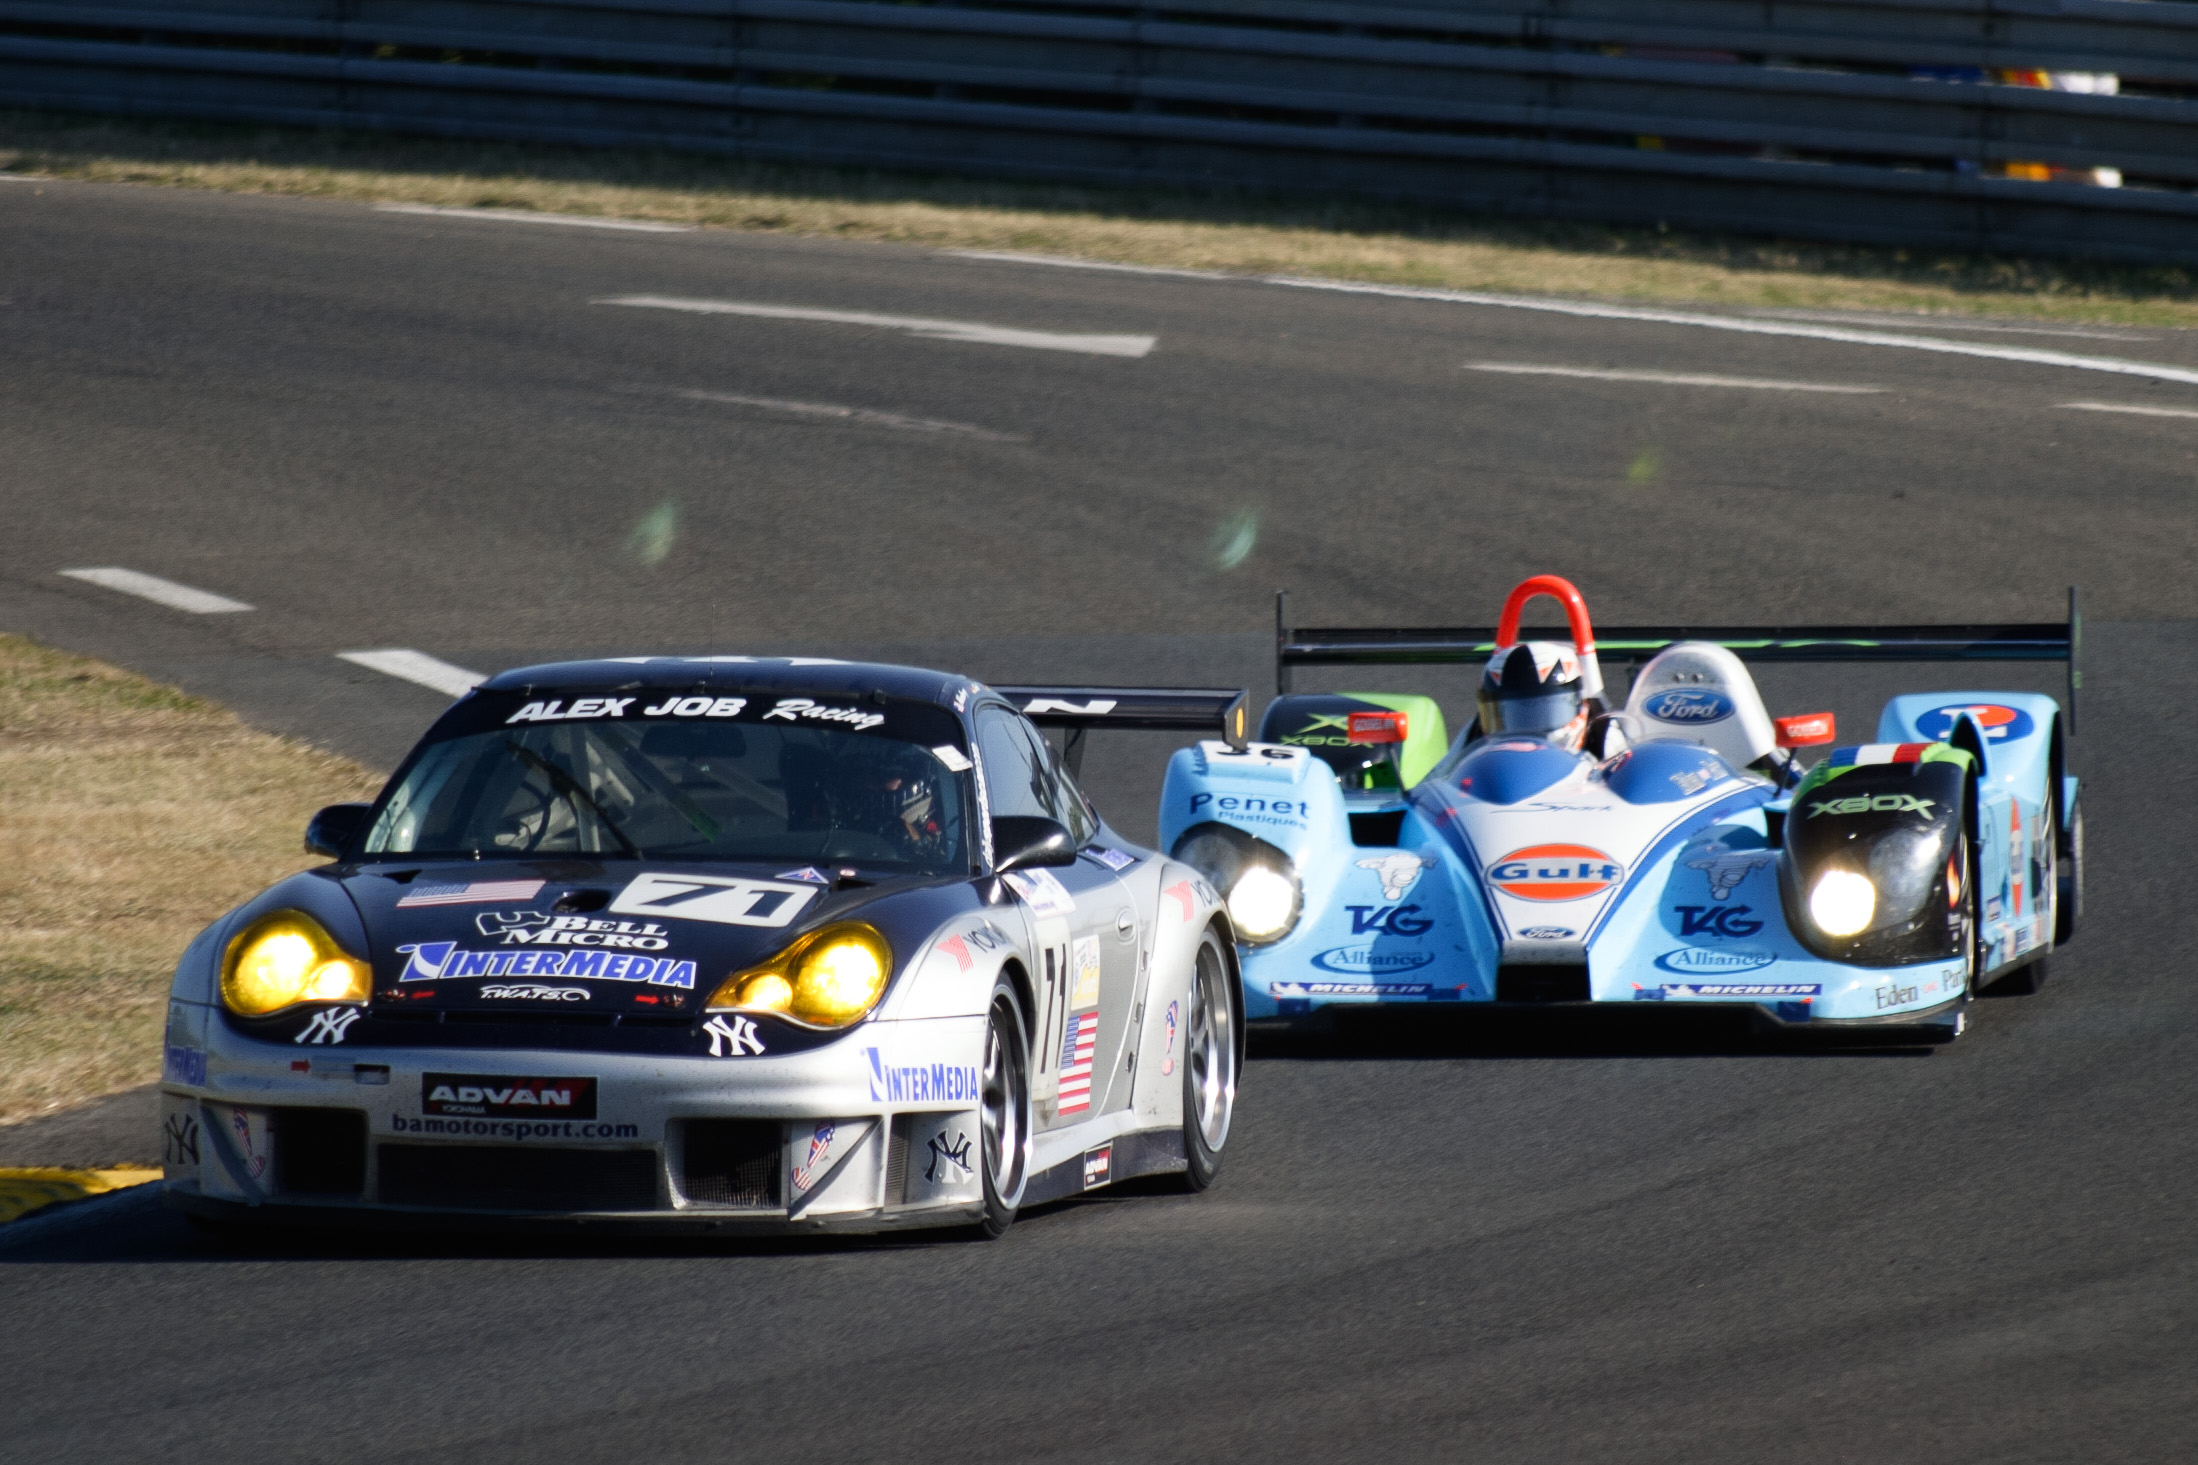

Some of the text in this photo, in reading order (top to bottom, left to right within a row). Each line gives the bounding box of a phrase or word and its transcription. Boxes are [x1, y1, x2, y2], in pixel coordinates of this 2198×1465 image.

[505, 697, 885, 731] ALEX JOB Racing
[1657, 691, 1720, 719] Ford
[1189, 792, 1310, 819] Penet
[1806, 794, 1937, 821] XBOX
[1491, 861, 1619, 882] Gulf
[637, 878, 793, 919] 71
[501, 928, 669, 951] MICRO
[547, 916, 669, 938] BELL
[438, 949, 697, 990] INTERMEDIA
[1332, 950, 1425, 966] Alliance
[1673, 951, 1766, 966] Alliance
[1308, 983, 1427, 993] MICHELIN
[1697, 985, 1817, 994] MICHELIN
[1874, 984, 1919, 1009] Eden
[884, 1063, 979, 1102] INTERMEDIA
[429, 1085, 571, 1106] ADVAN
[392, 1114, 638, 1141] bamotorsport.com
